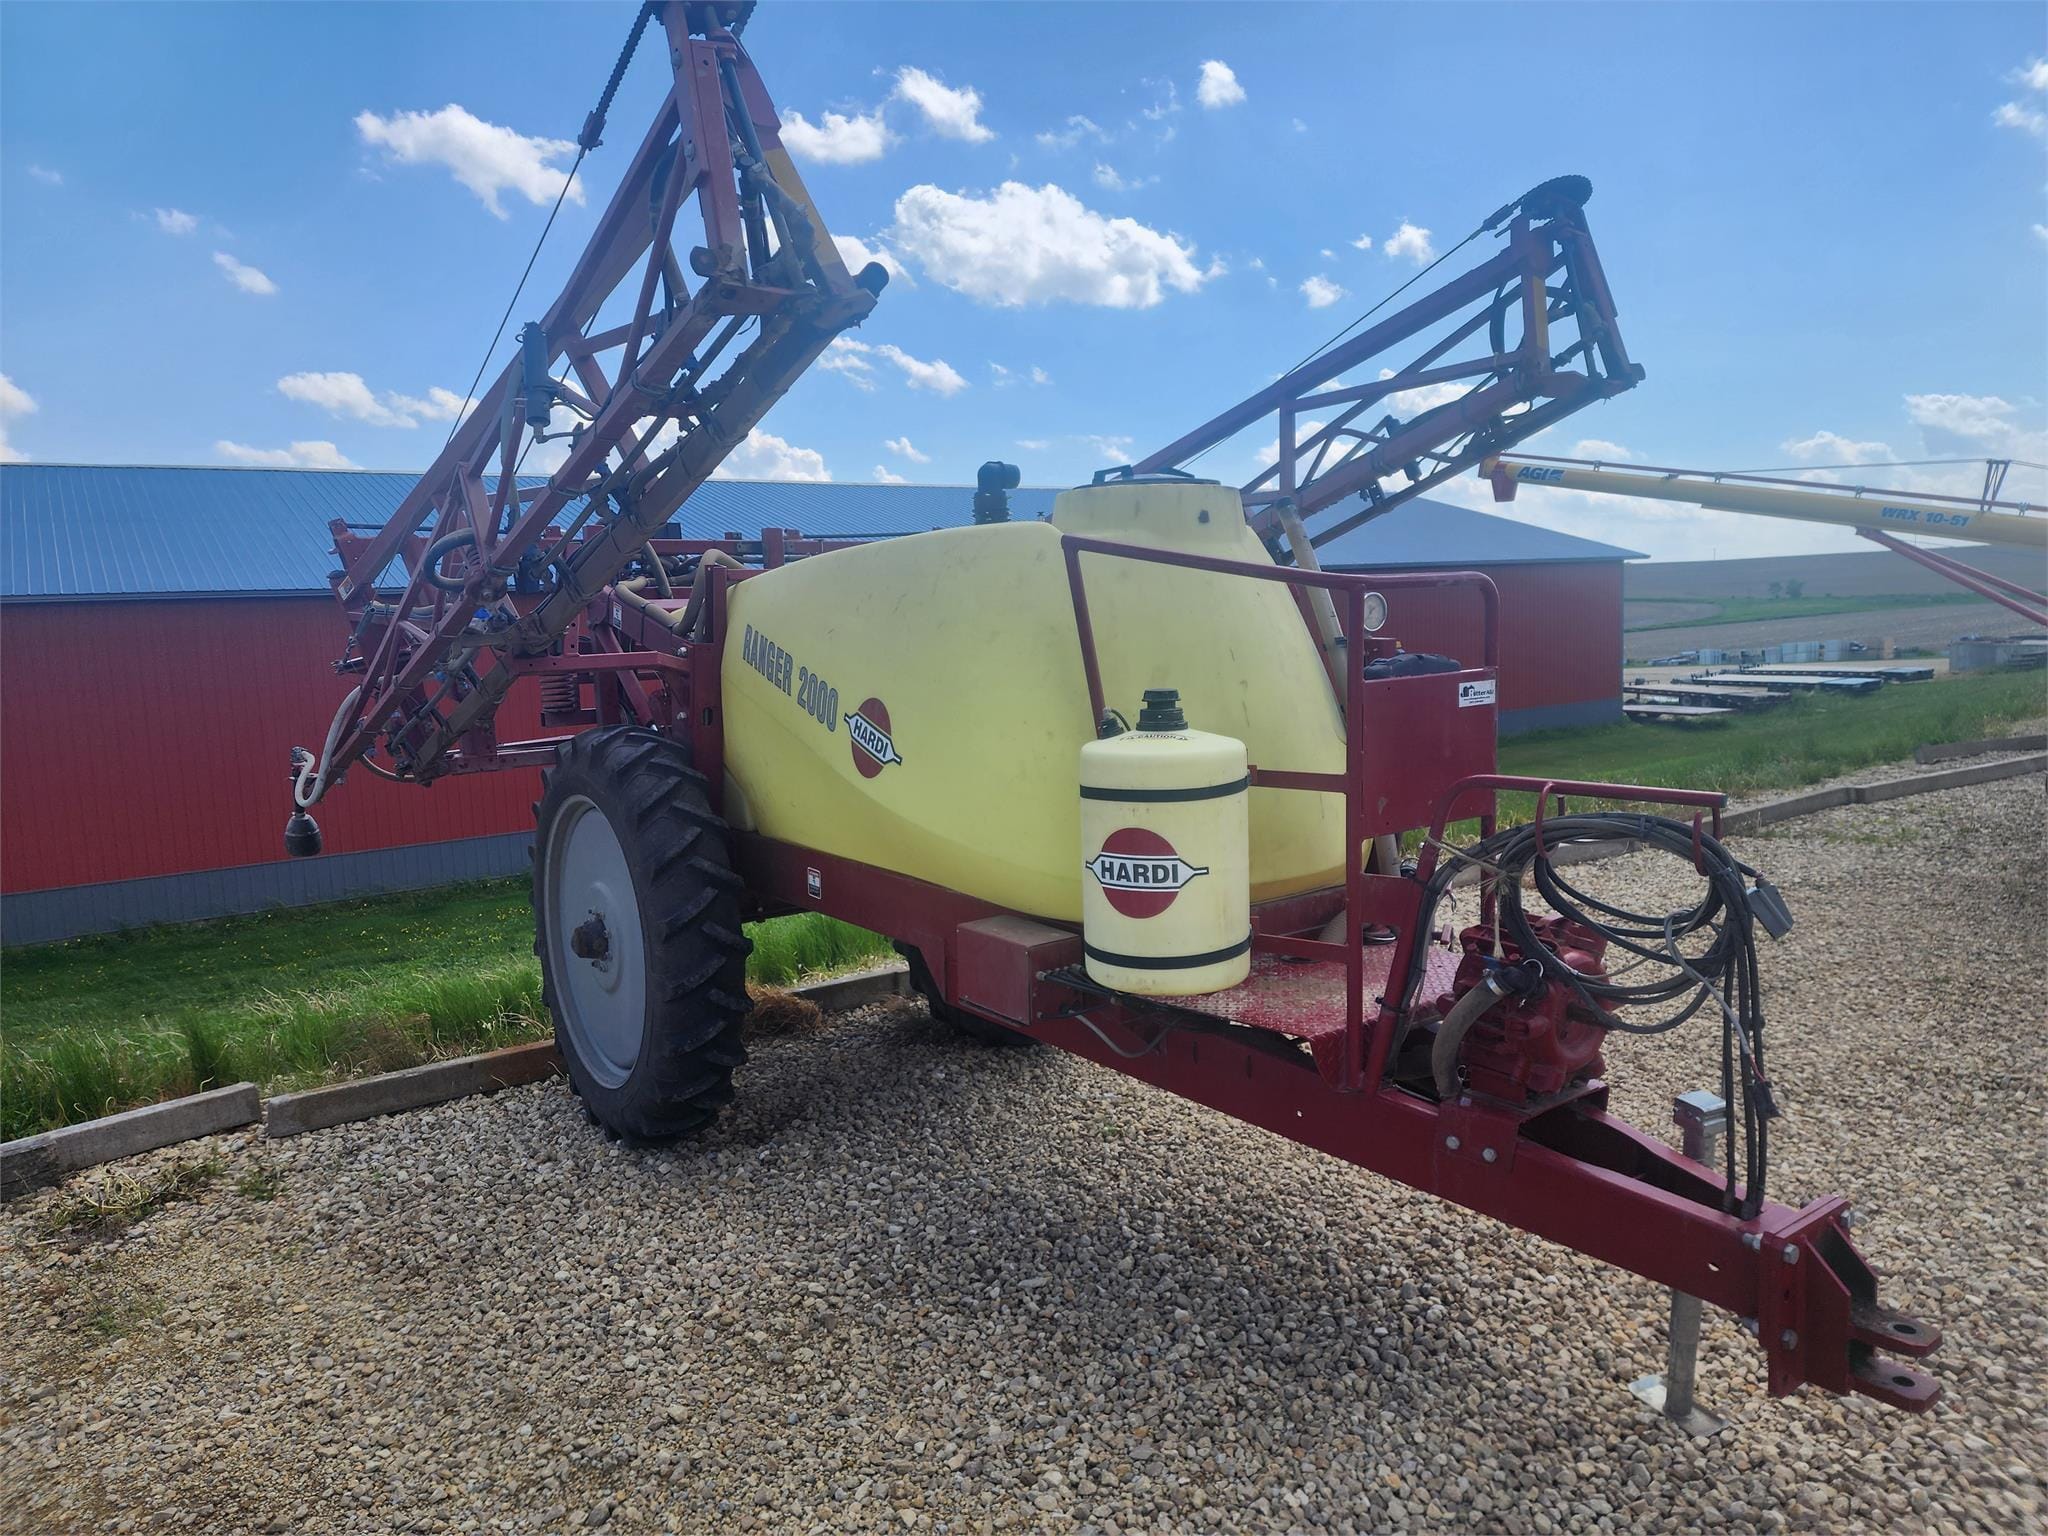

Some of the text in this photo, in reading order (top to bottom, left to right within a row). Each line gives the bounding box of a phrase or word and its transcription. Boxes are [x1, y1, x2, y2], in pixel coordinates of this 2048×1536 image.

[1517, 466, 1549, 480] AGI
[1881, 507, 1970, 528] WRX 10-51
[742, 624, 838, 732] RANGER 2000
[853, 719, 889, 759] HARDI
[1100, 860, 1179, 884] HARDI
